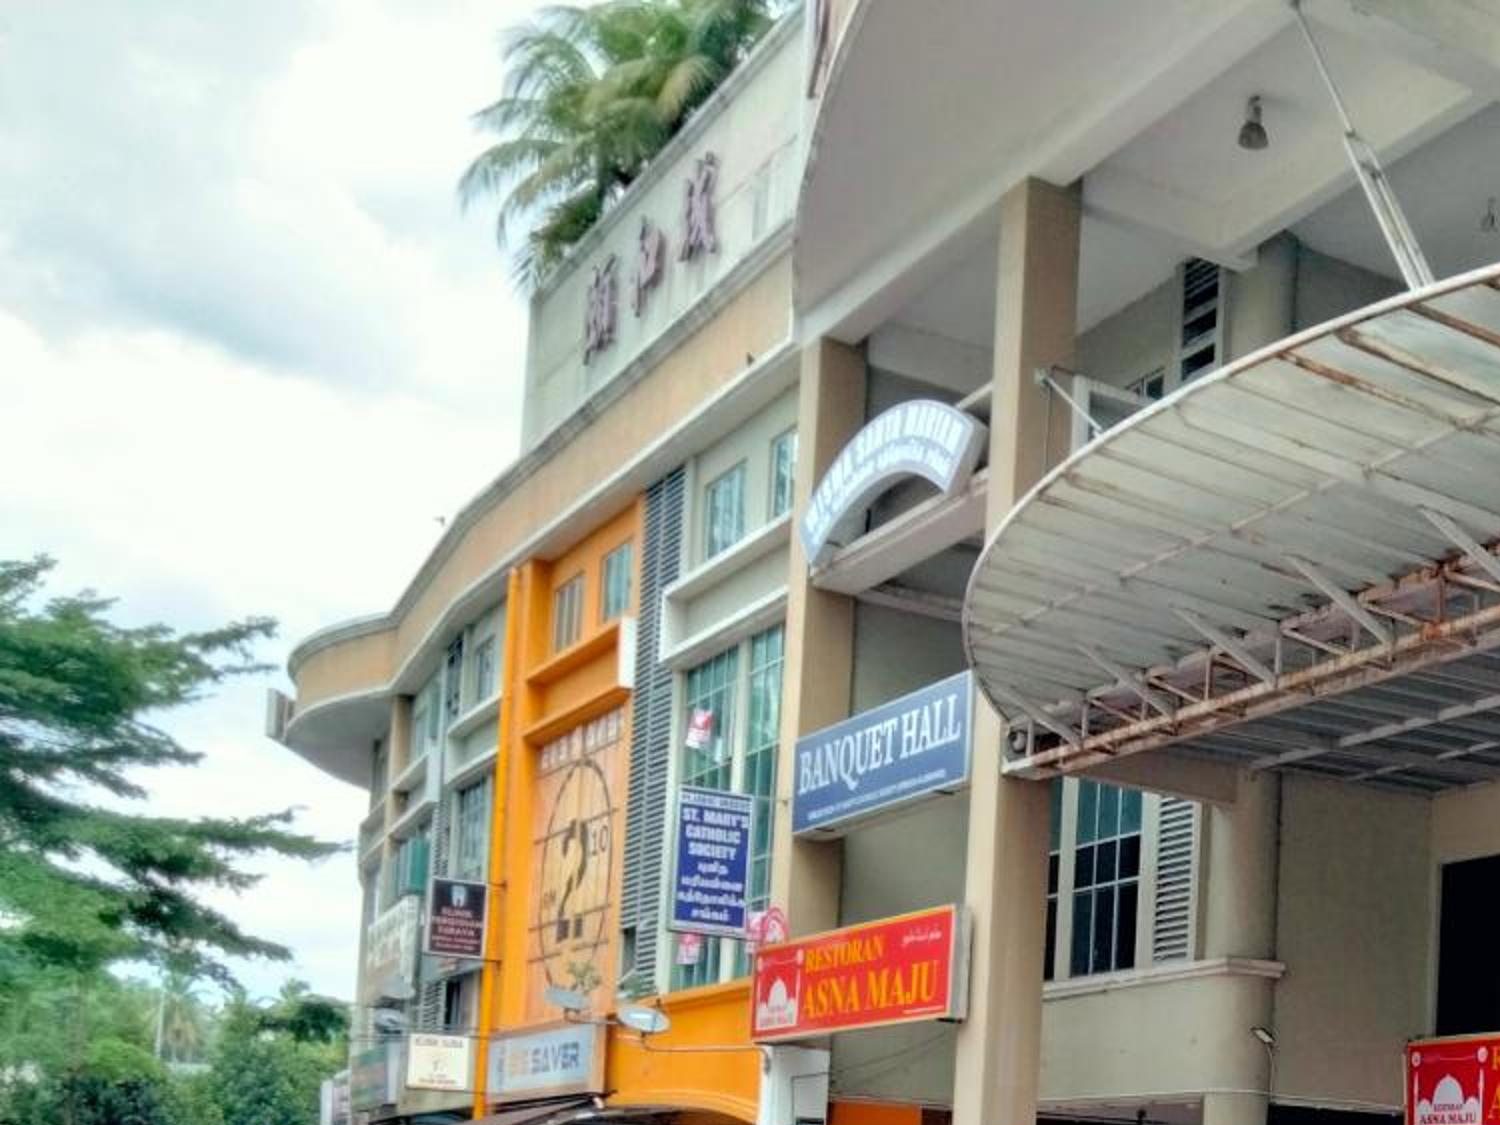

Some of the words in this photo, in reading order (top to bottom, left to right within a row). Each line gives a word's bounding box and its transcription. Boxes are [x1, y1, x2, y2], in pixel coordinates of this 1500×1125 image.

[797, 716, 899, 797] BANQUET
[899, 693, 962, 760] HALL
[685, 823, 741, 844] CATHOLIC
[703, 809, 748, 829] MARY'S
[687, 842, 737, 861] SOCIETY
[805, 935, 886, 973] RESTORAN
[803, 974, 861, 1020] ASNA
[864, 960, 939, 1010] MAJU
